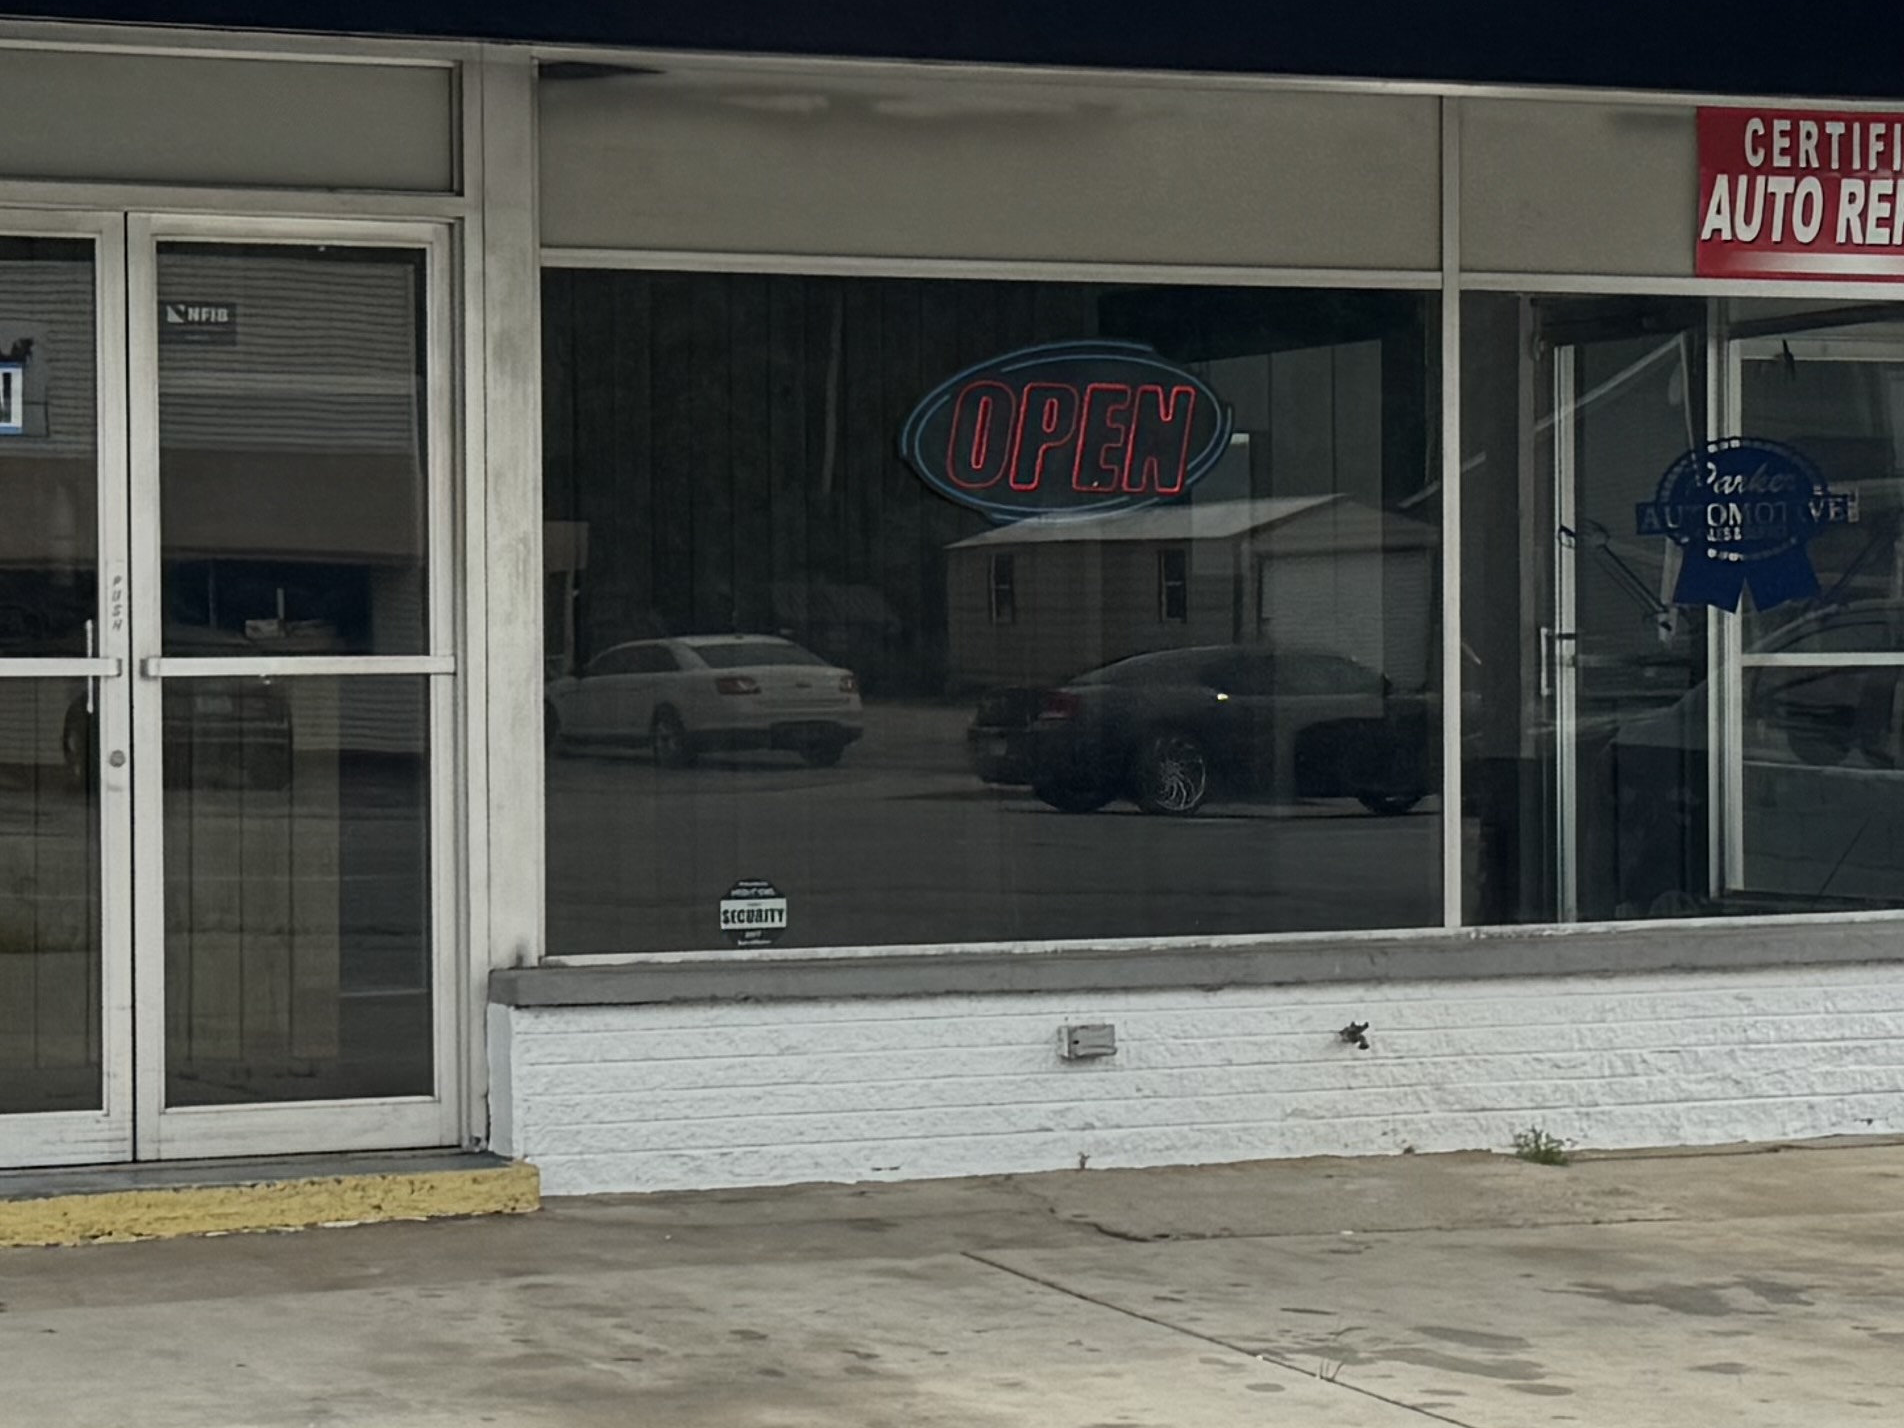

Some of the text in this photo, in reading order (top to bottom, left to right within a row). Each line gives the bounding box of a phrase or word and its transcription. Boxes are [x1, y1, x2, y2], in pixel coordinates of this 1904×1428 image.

[1700, 174, 1824, 244] AUTO
[187, 306, 229, 323] NFIB
[945, 379, 1197, 495] OPEN
[111, 575, 123, 632] PUSH
[721, 908, 785, 925] SECURITY
